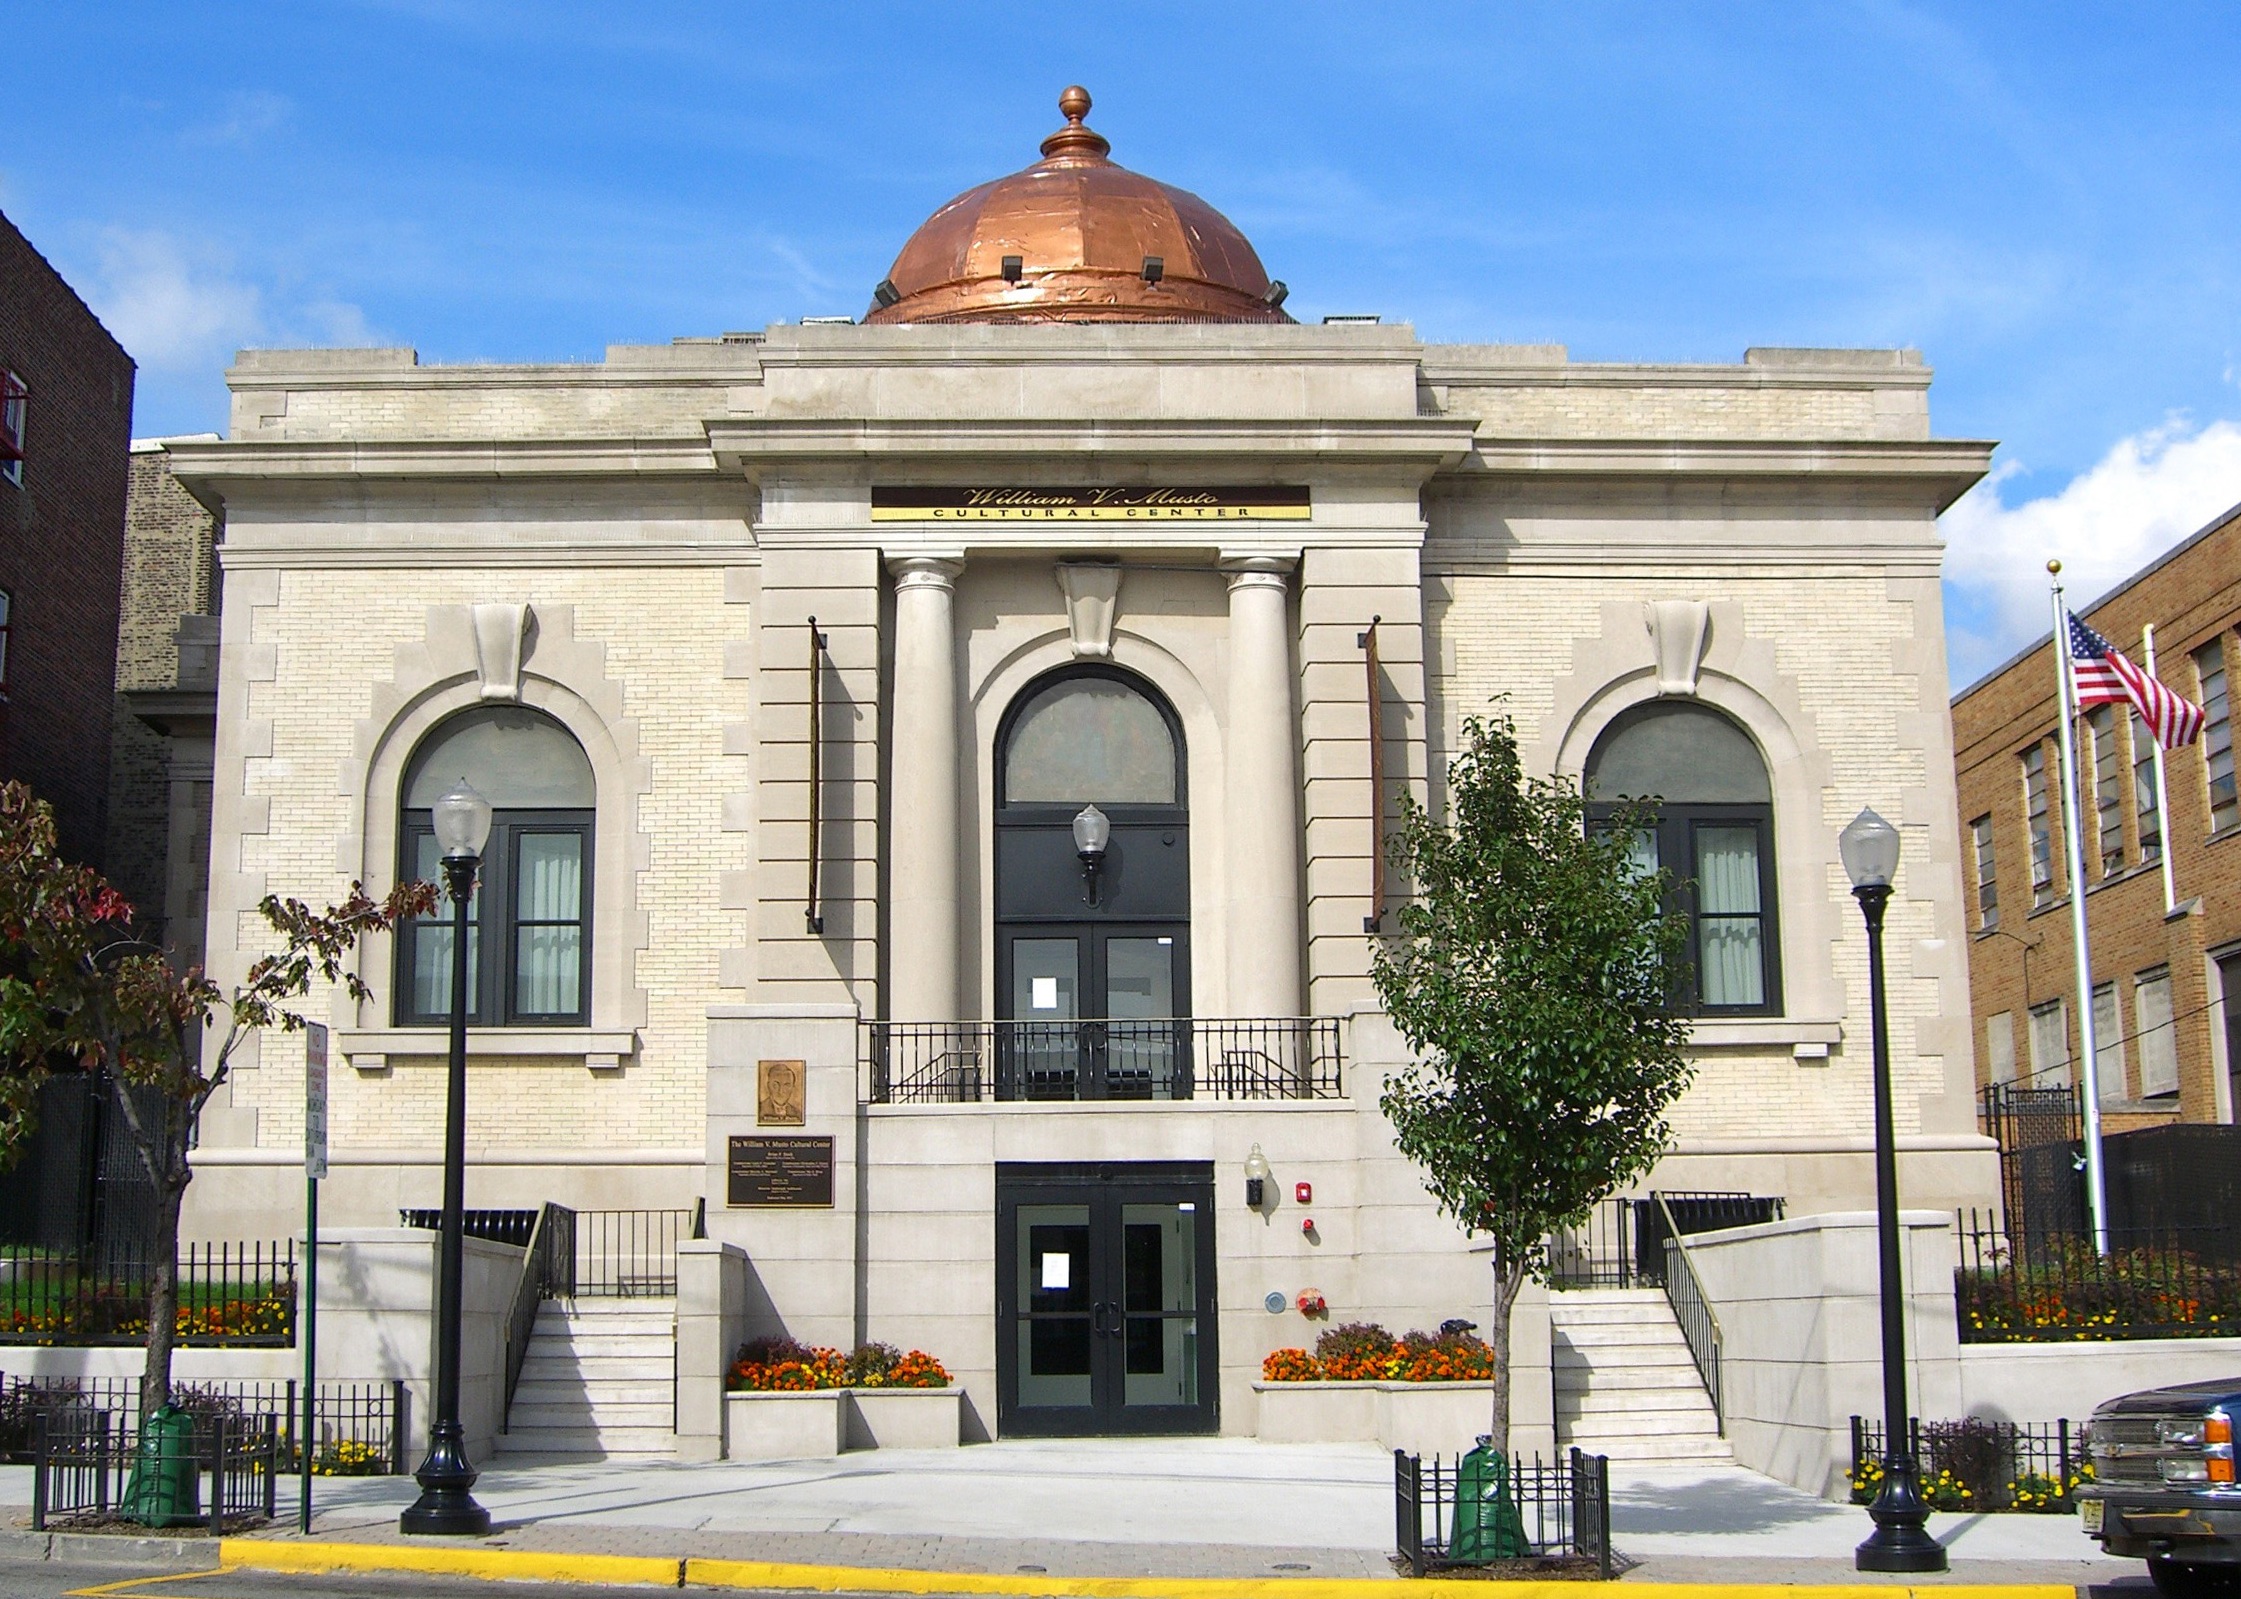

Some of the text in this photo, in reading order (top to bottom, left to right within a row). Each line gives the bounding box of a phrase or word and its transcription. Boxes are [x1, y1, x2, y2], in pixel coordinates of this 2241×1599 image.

[963, 488, 1219, 505] William V. Musto
[932, 508, 1249, 518] CULTURAL CENTER
